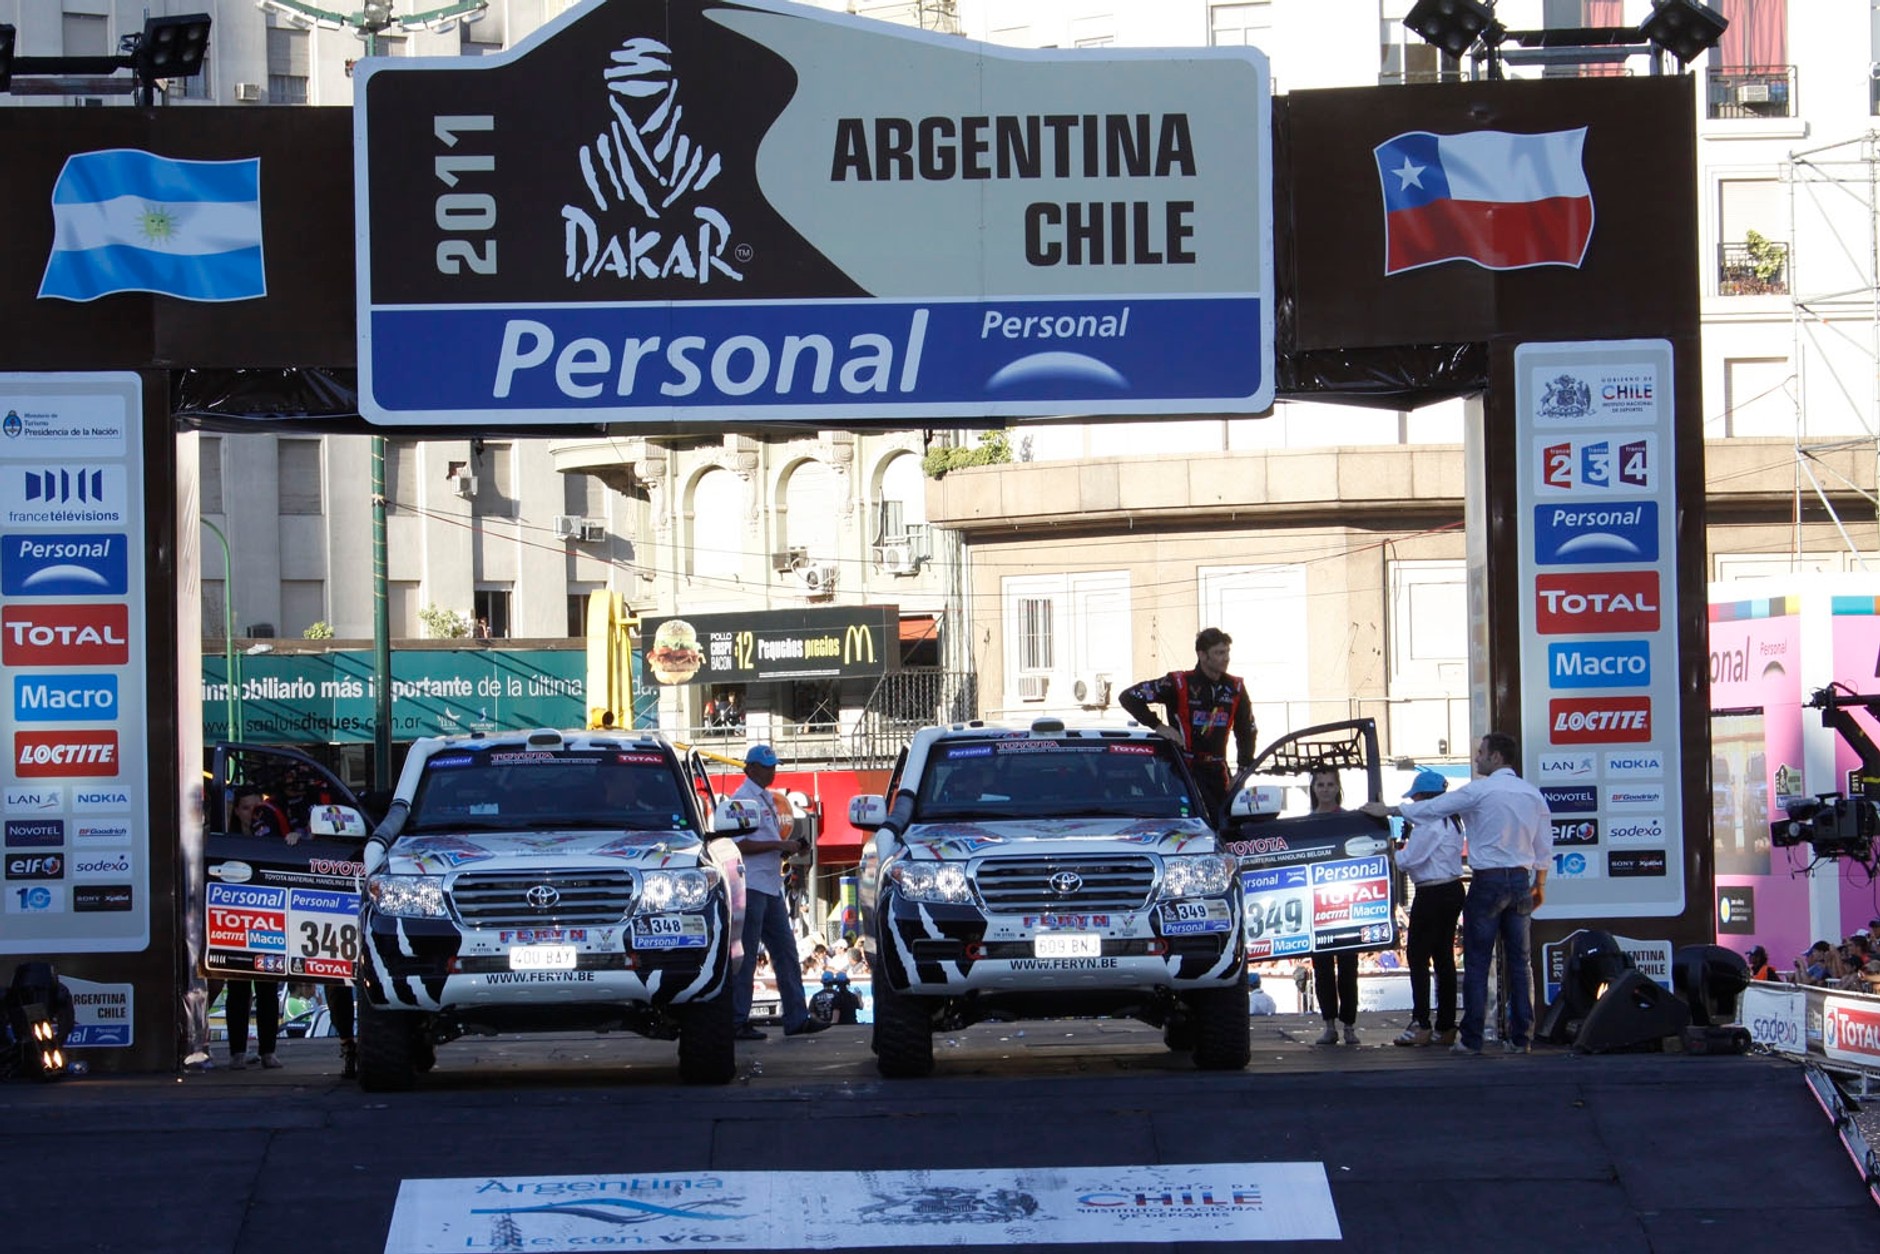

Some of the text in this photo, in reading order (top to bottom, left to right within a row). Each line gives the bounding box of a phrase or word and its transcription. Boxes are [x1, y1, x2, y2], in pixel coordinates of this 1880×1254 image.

[830, 113, 1196, 181] ARGENTINA
[434, 115, 497, 274] 2011
[1025, 201, 1196, 266] CHILE
[562, 204, 743, 283] DAKAR
[981, 307, 1130, 339] Personal
[493, 309, 929, 399] Personal
[1602, 384, 1652, 399] CHILE
[25, 426, 119, 436] Presidencia de la Nación
[1550, 455, 1571, 482] 2
[1588, 454, 1608, 481] 3
[1624, 452, 1646, 480] 4
[1552, 506, 1642, 527] Personal
[19, 539, 111, 558] Personal
[1539, 589, 1657, 615] TOTAL
[6, 621, 125, 645] TOTAL
[710, 632, 732, 640] POLLO
[758, 635, 840, 660] Pequeños precios
[1760, 641, 1788, 656] Personal
[711, 656, 732, 670] BACON
[1556, 652, 1646, 676] Macro
[1710, 636, 1750, 684] onal
[321, 675, 363, 698] más
[369, 676, 472, 702] iportante
[477, 676, 500, 697] de
[507, 676, 522, 697] la
[529, 674, 582, 697] última
[21, 685, 113, 709] Macro
[1554, 711, 1647, 731] LOCTITE
[996, 741, 1059, 749] TOYOTA
[1111, 745, 1153, 753] TOTAL
[19, 744, 115, 764] LOCTITE
[491, 752, 554, 760] TOYOTA
[619, 754, 662, 762] TOTAL
[1542, 762, 1574, 771] LAN
[1611, 759, 1659, 769] NOKIA
[8, 795, 40, 804] LAN
[77, 794, 127, 803] NOKIA
[1544, 792, 1593, 802] NOVOTEL
[9, 826, 60, 836] NOVOTEL
[1552, 824, 1577, 839] elf
[1609, 825, 1662, 837] sodexo
[1226, 837, 1289, 856] TOYOTA
[10, 859, 42, 873] elf
[76, 859, 129, 872] sodexo
[1315, 858, 1384, 882] Personal
[211, 886, 284, 908] Personal
[292, 894, 339, 909] Personal
[1179, 905, 1206, 919] 349
[1248, 898, 1303, 938] 349
[1315, 909, 1349, 920] LOCTITE
[1353, 904, 1387, 917] Macro
[210, 910, 283, 931] TOTAL
[652, 919, 681, 933] 348
[1023, 915, 1110, 929] FERYN
[1166, 920, 1206, 933] Personal
[210, 930, 246, 941] LOCTITE
[250, 932, 285, 945] Macro
[300, 921, 357, 960] 348
[500, 930, 587, 944] FERYN
[636, 936, 680, 947] Personal
[1275, 939, 1309, 951] Macro
[306, 961, 352, 975] TOTAL
[1010, 958, 1118, 971] WWW.FERYN.BE
[1552, 951, 1563, 978] 2011
[1637, 963, 1665, 975] CHILE
[486, 971, 595, 985] WWW.FERYN.BE
[97, 1007, 126, 1018] CHILE
[1753, 1011, 1798, 1045] sodexo
[476, 1178, 723, 1196] Argentina
[1078, 1191, 1263, 1207] CHILE
[567, 1236, 643, 1246] con
[656, 1234, 748, 1245] vos
